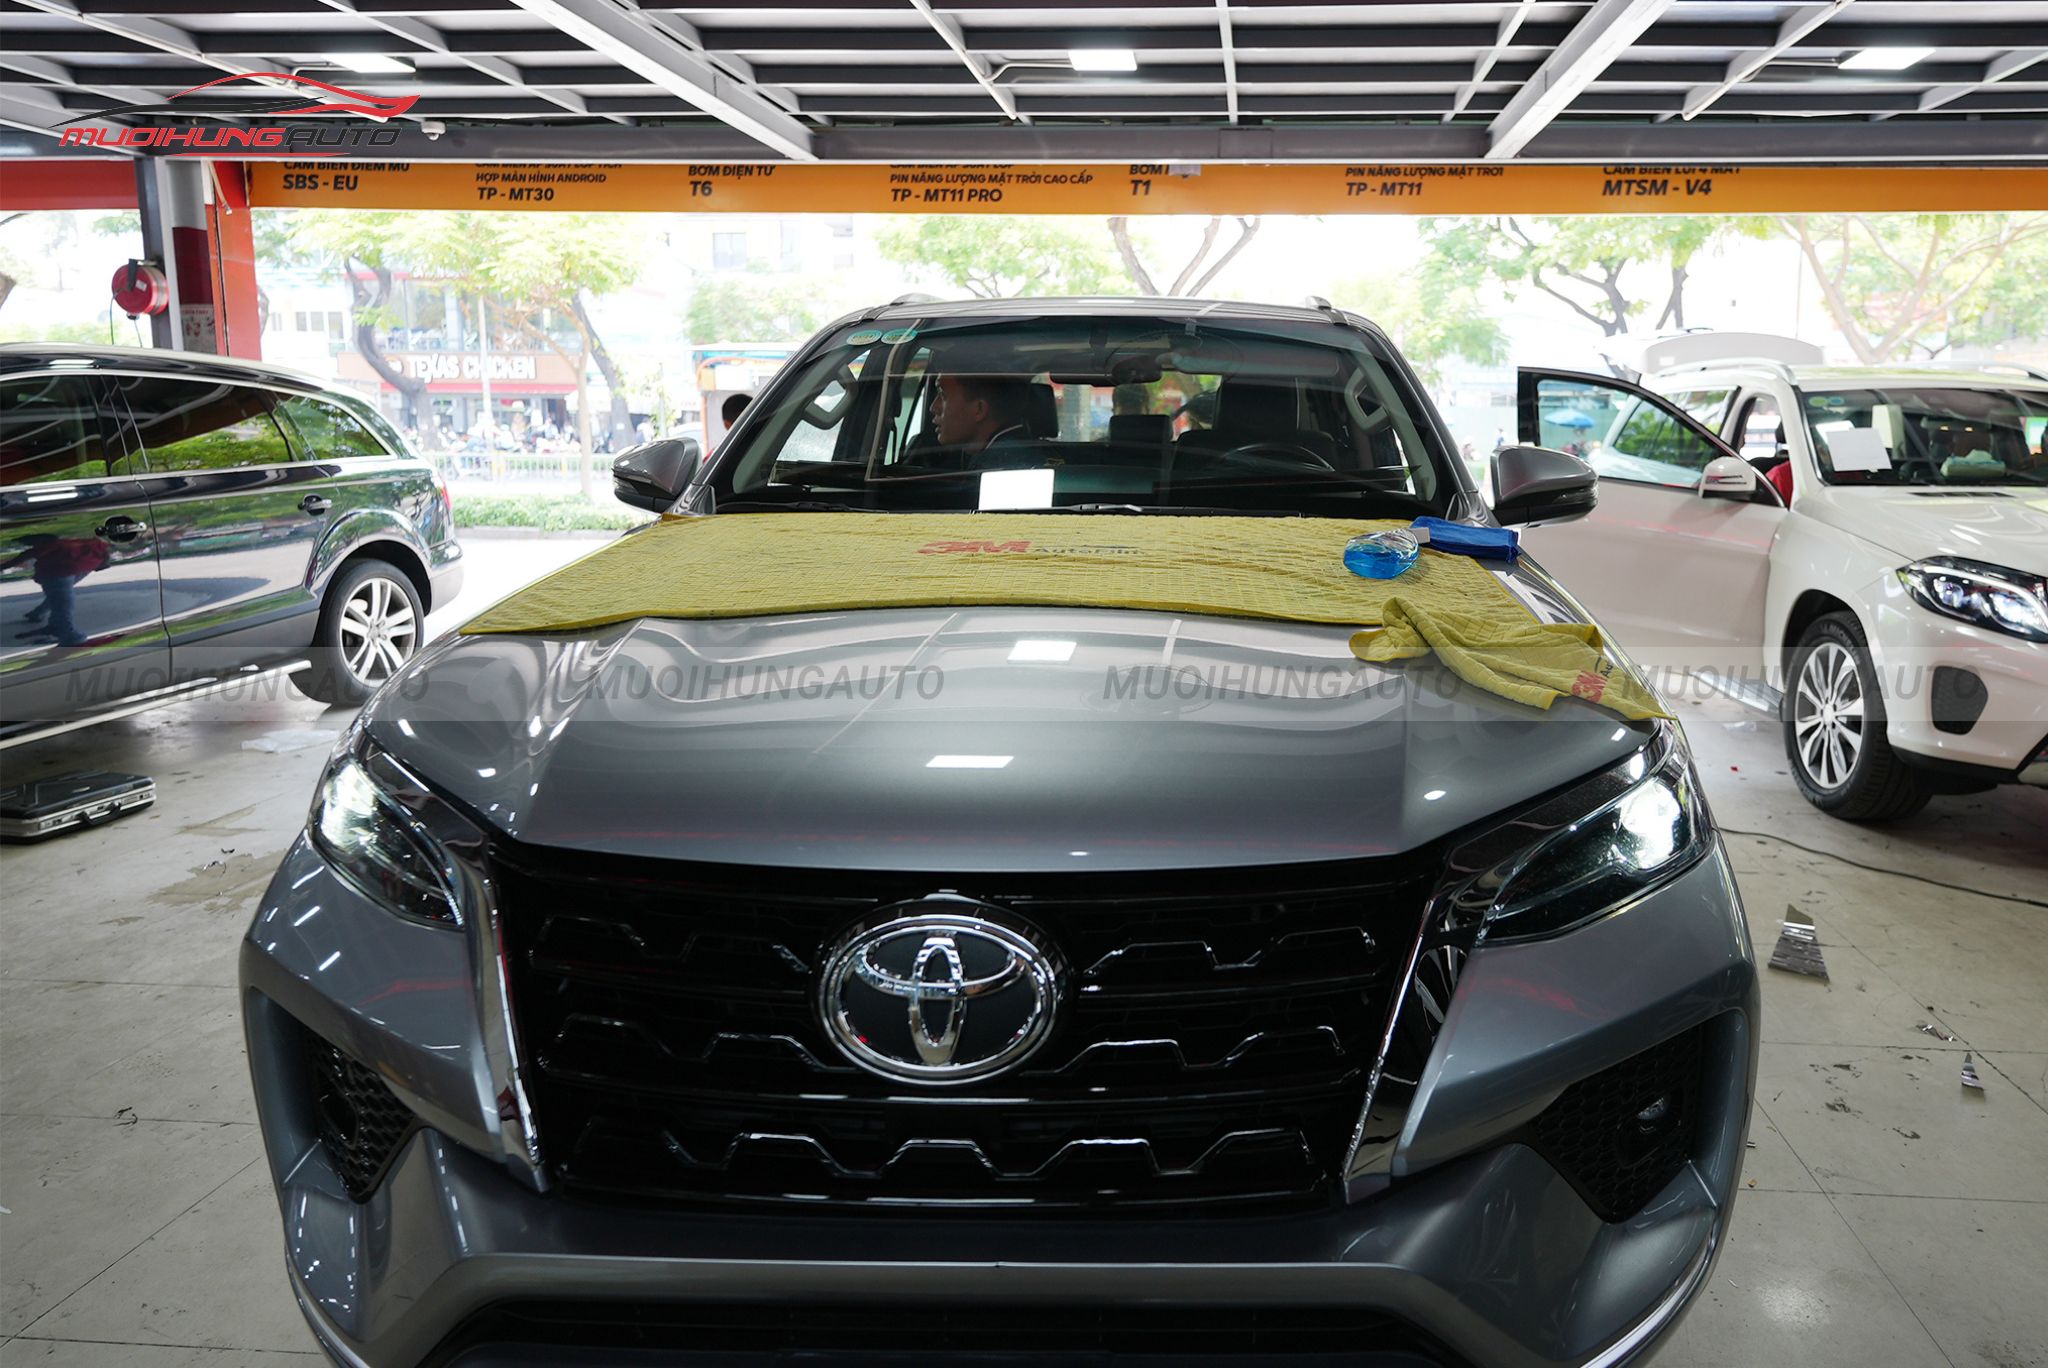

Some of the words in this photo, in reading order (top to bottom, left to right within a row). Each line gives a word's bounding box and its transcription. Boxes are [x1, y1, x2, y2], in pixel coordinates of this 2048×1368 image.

[557, 173, 607, 184] ANDROID
[889, 173, 909, 184] PIN
[1043, 174, 1068, 185] CAO
[1345, 167, 1366, 177] PIN
[283, 174, 319, 190] SBS
[333, 175, 359, 191] EU
[690, 180, 713, 197] T6
[1130, 179, 1152, 196] T1
[1346, 182, 1368, 196] TP
[1379, 182, 1423, 196] MT11
[1602, 179, 1669, 196] MTSM
[1685, 179, 1713, 196] V4
[477, 187, 498, 200] TP
[509, 187, 555, 201] MT30
[891, 188, 912, 202] TP
[923, 188, 966, 202] MT11
[967, 188, 1003, 203] PRO
[406, 352, 461, 384] TEXAS
